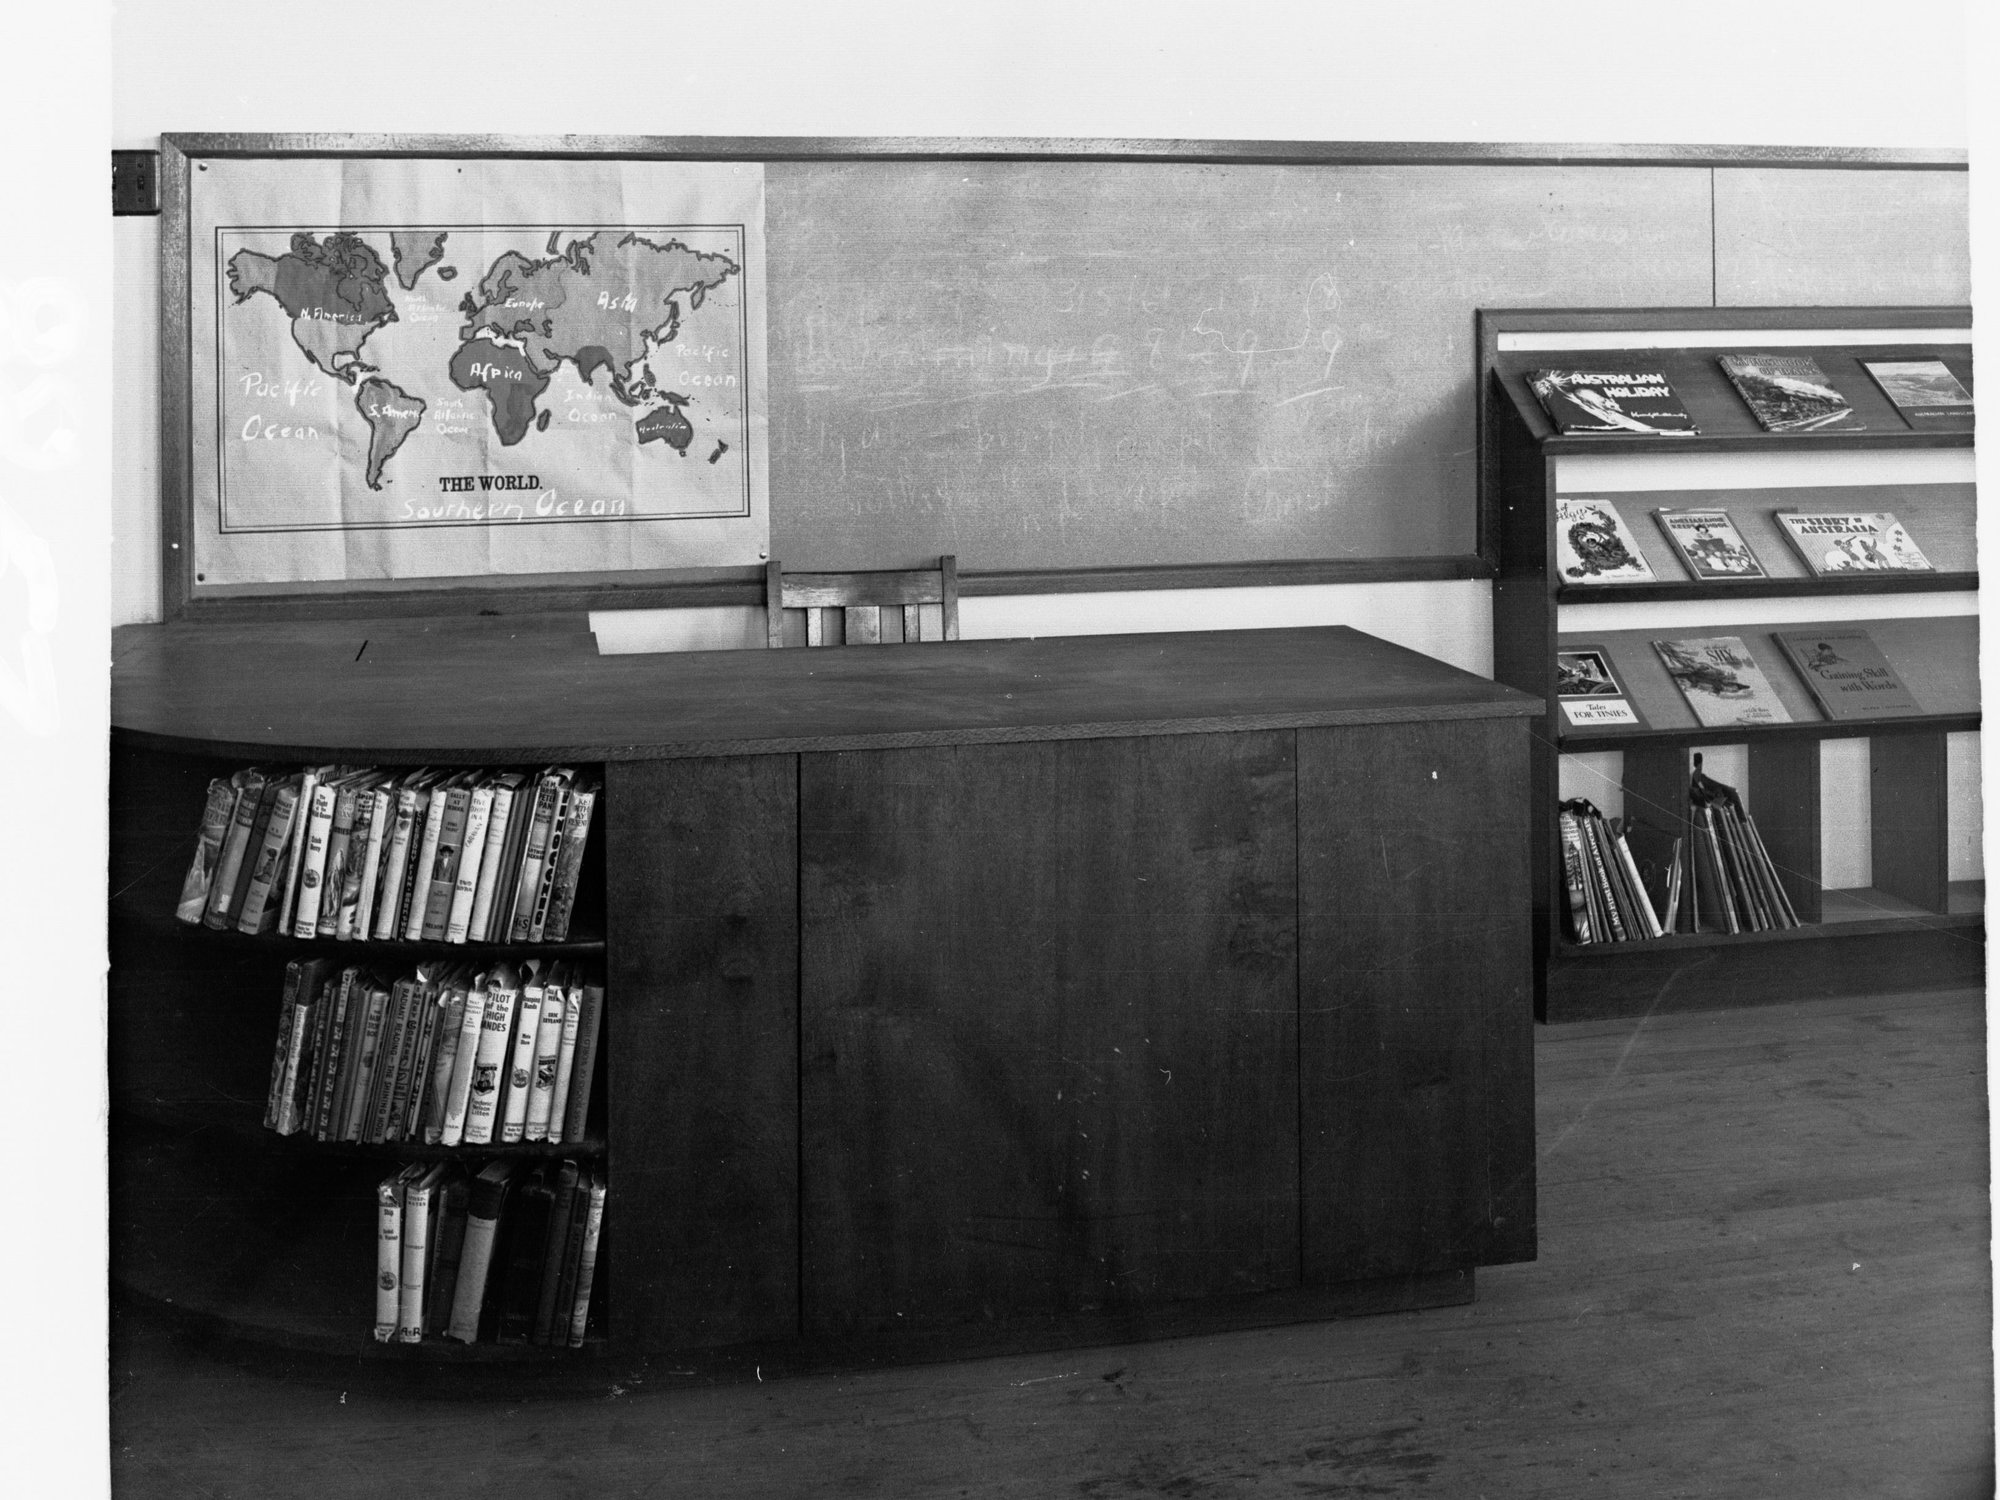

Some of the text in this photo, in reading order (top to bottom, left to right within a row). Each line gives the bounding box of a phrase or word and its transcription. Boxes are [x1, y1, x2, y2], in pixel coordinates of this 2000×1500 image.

[504, 298, 545, 311] Europe
[597, 291, 637, 313] Asia
[675, 343, 730, 363] Pacific
[470, 363, 523, 382] Africa
[679, 371, 737, 388] Ocean
[1571, 373, 1665, 385] AUSTRALIAN
[239, 372, 322, 407] Pacific
[1603, 387, 1670, 397] HOLIDAY
[568, 408, 617, 424] Ocean
[242, 414, 319, 441] Ocean
[439, 474, 544, 493] THE WORLD.
[400, 488, 626, 522] Southern Ocean
[1806, 517, 1850, 526] STORY
[1801, 525, 1879, 534] AUSTRALIA
[1820, 666, 1889, 681] Gaining Skill
[1840, 680, 1898, 692] with Words
[1573, 710, 1629, 719] FOR TINIES
[450, 792, 465, 800] SALLY
[539, 801, 552, 810] PAN
[1584, 816, 1600, 858] Aircraft
[535, 791, 570, 926] PINOCCHIO
[1599, 866, 1610, 889] Book
[488, 991, 511, 1004] PILOT
[485, 1002, 509, 1012] of the
[486, 1010, 505, 1022] HIGH
[482, 1021, 506, 1032] ANDES
[375, 988, 409, 1137] RADIANT READING THE SHINING HOUR
